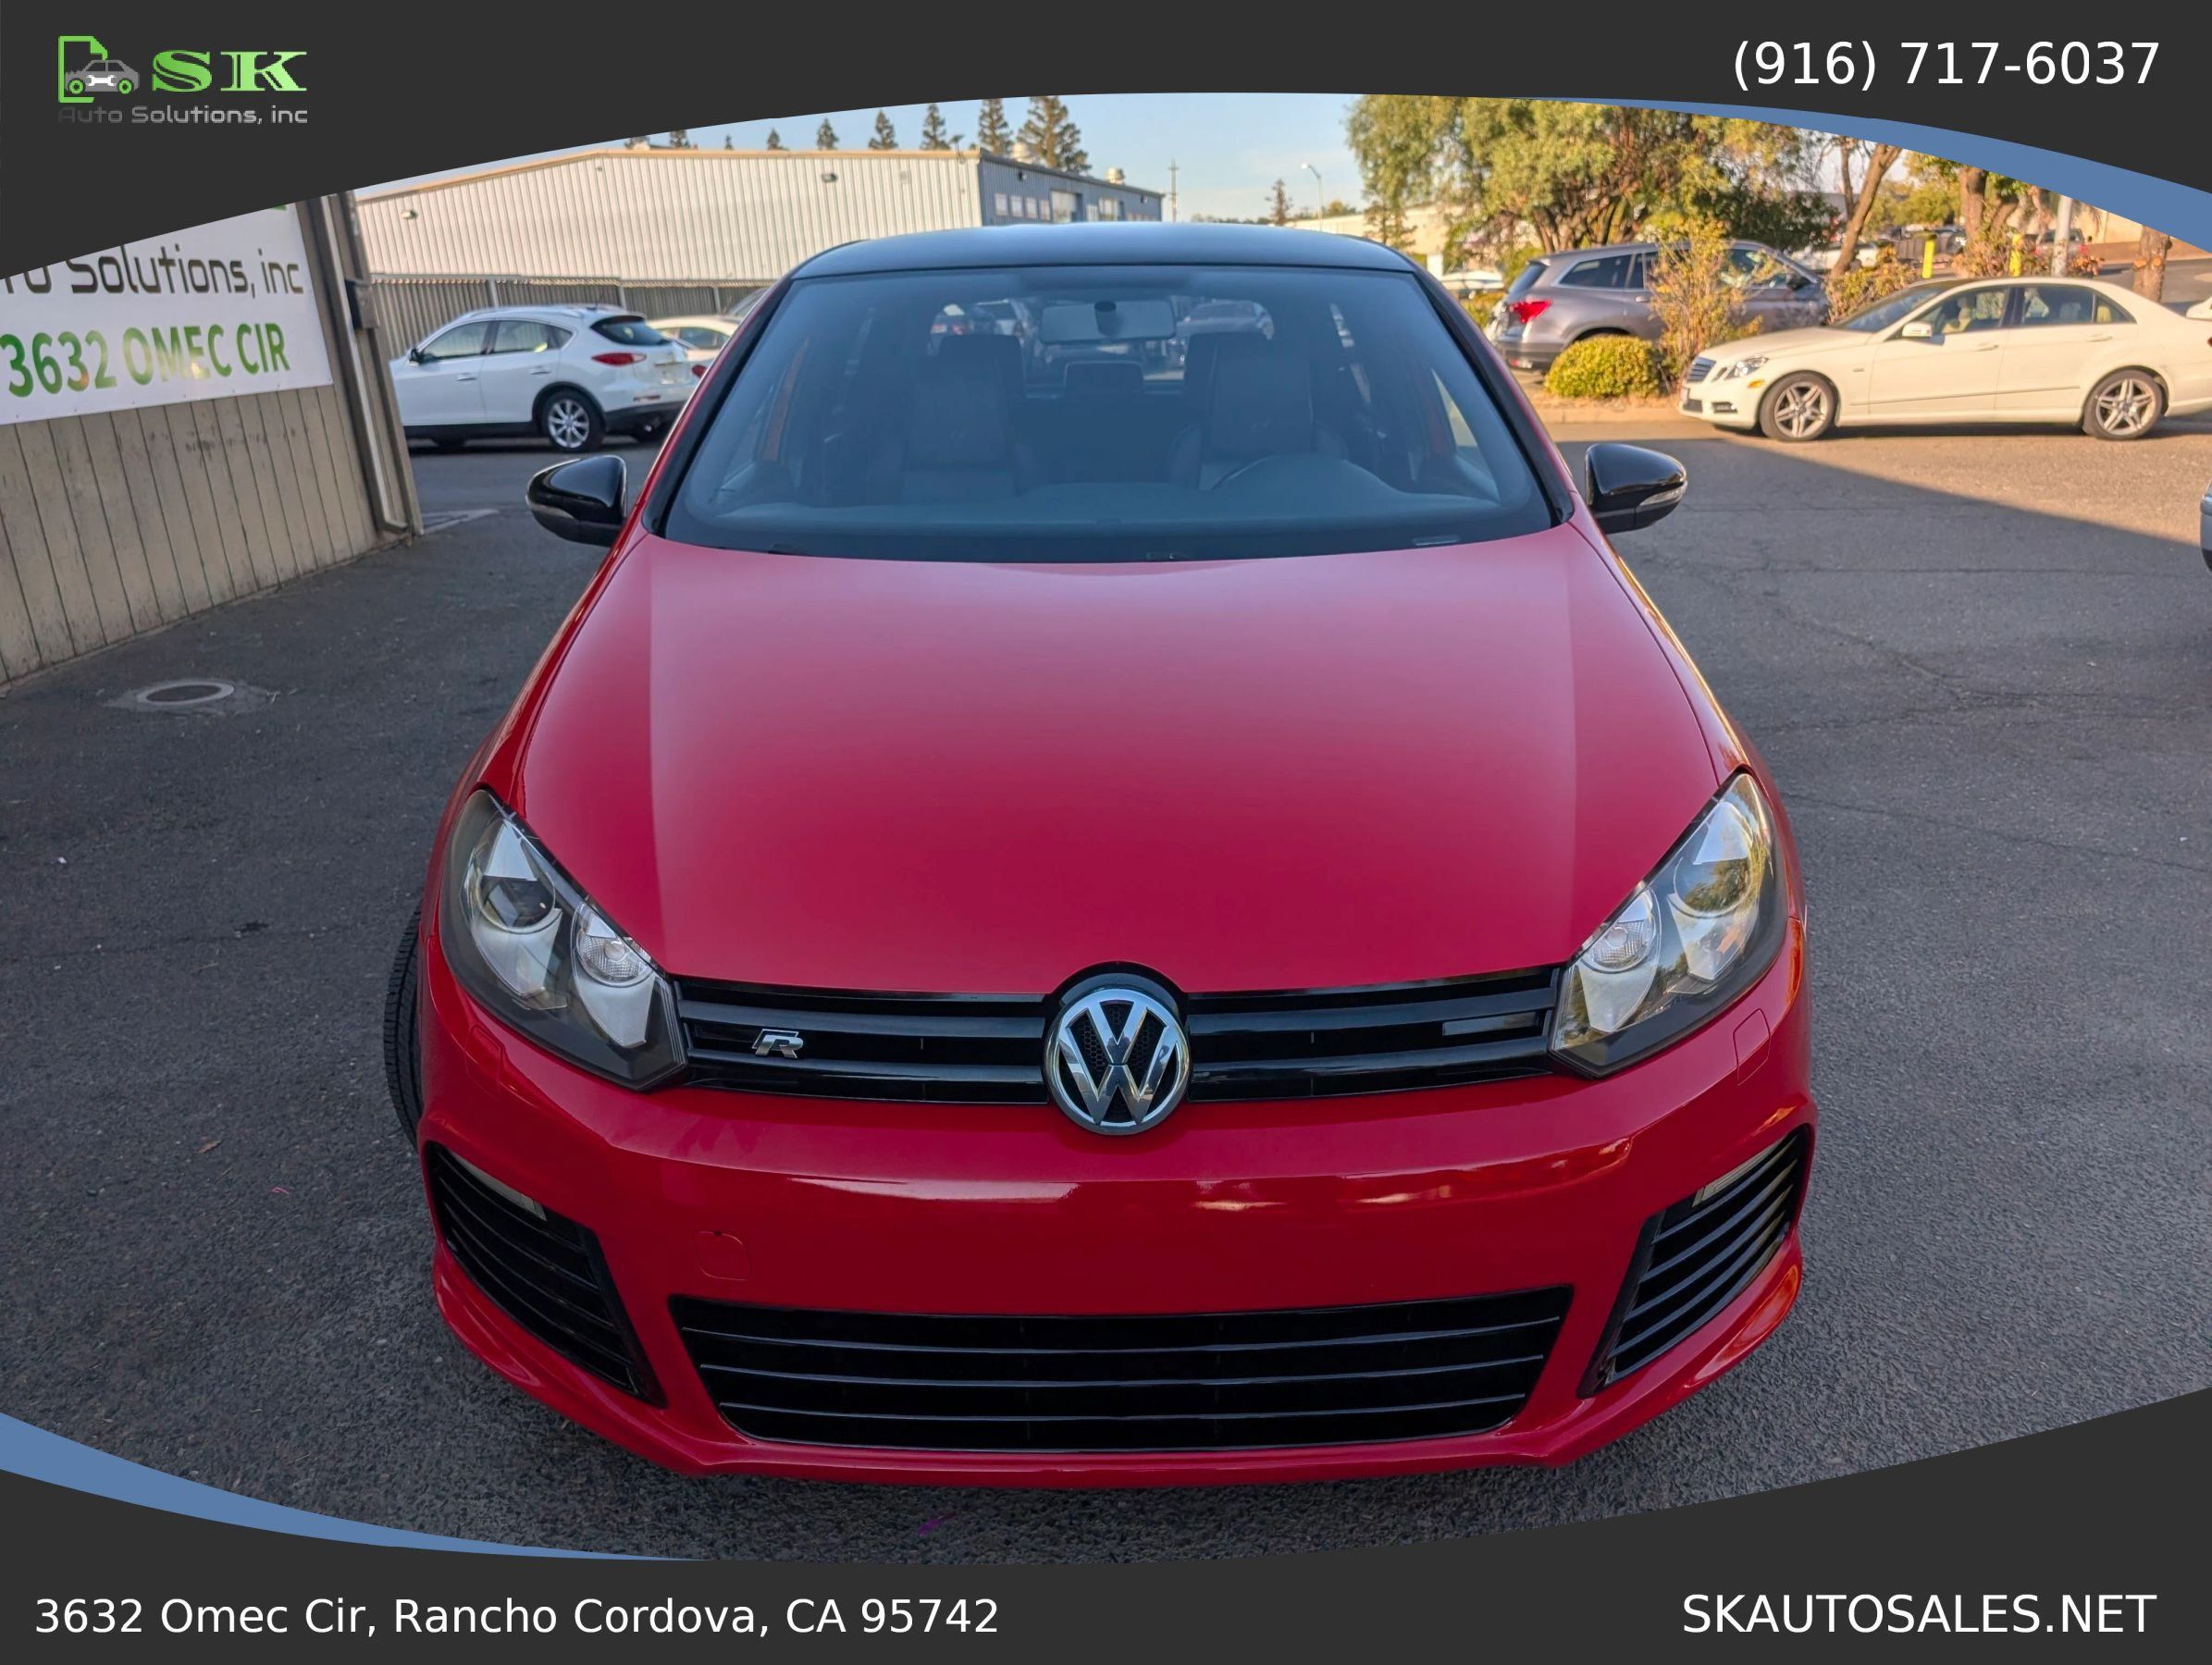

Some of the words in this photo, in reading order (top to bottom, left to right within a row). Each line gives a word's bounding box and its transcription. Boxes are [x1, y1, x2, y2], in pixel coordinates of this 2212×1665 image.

[257, 248, 304, 295] inc
[0, 329, 117, 398] 3632
[122, 324, 232, 386] OMEC
[236, 323, 291, 375] CIR
